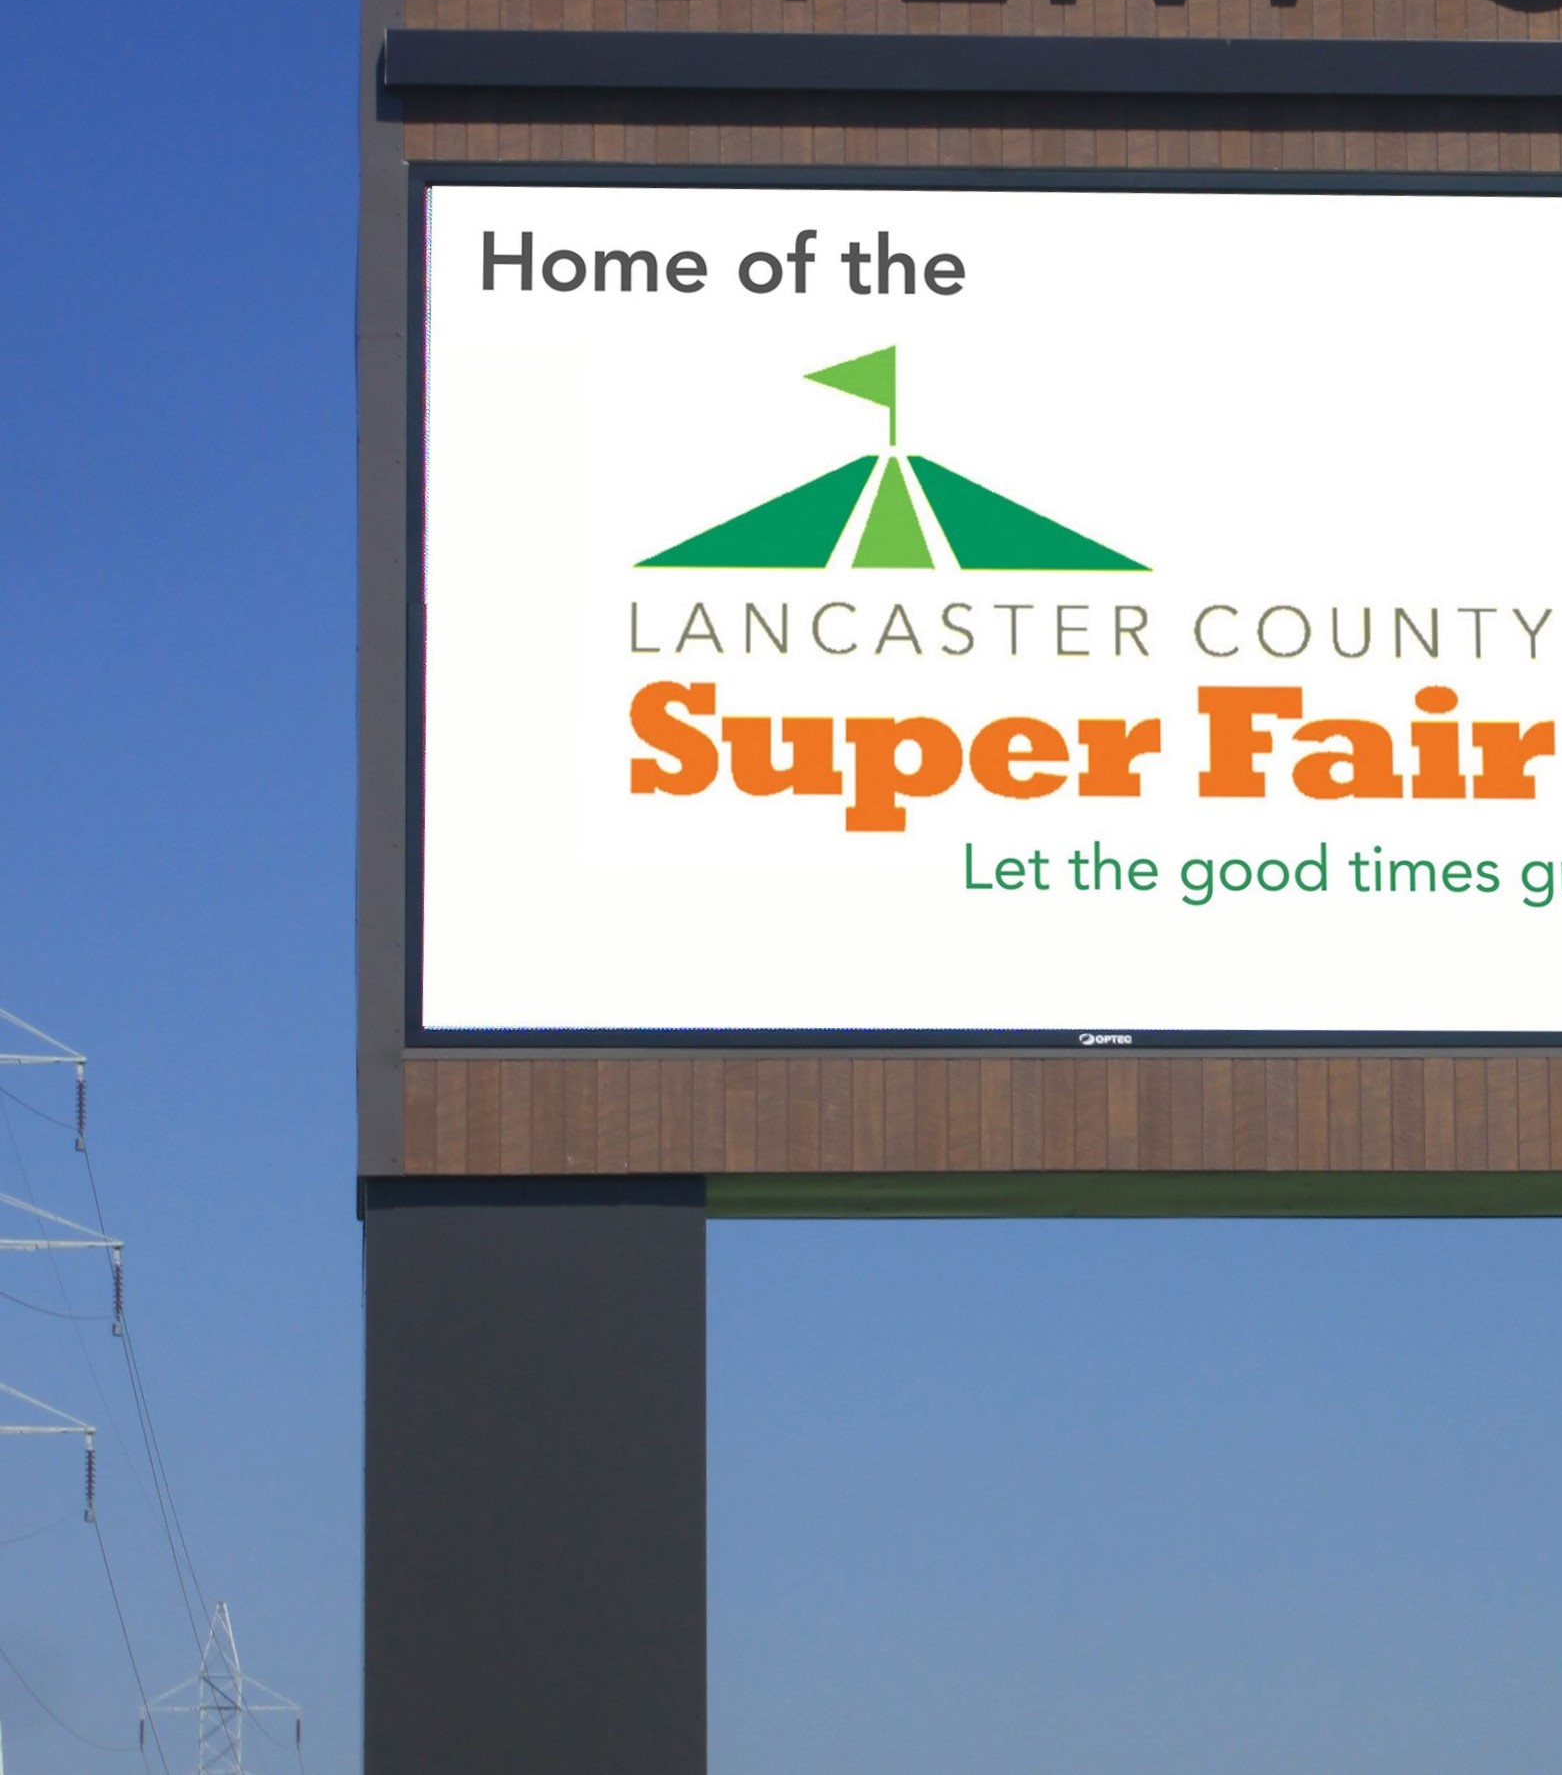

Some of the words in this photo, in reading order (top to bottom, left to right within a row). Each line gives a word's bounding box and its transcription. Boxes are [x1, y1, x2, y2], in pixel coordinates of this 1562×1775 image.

[482, 230, 708, 294] Home
[738, 229, 818, 295] of
[840, 230, 966, 296] the
[630, 601, 1150, 657] LANCASTER
[1193, 604, 1554, 661] COUNTY
[628, 680, 1162, 833] Super
[1197, 684, 1556, 801] Fair
[964, 842, 1050, 892] Let
[1067, 840, 1159, 893] the
[1180, 841, 1328, 907] good
[1348, 844, 1501, 894] times
[1095, 1034, 1133, 1045] OPTEC
